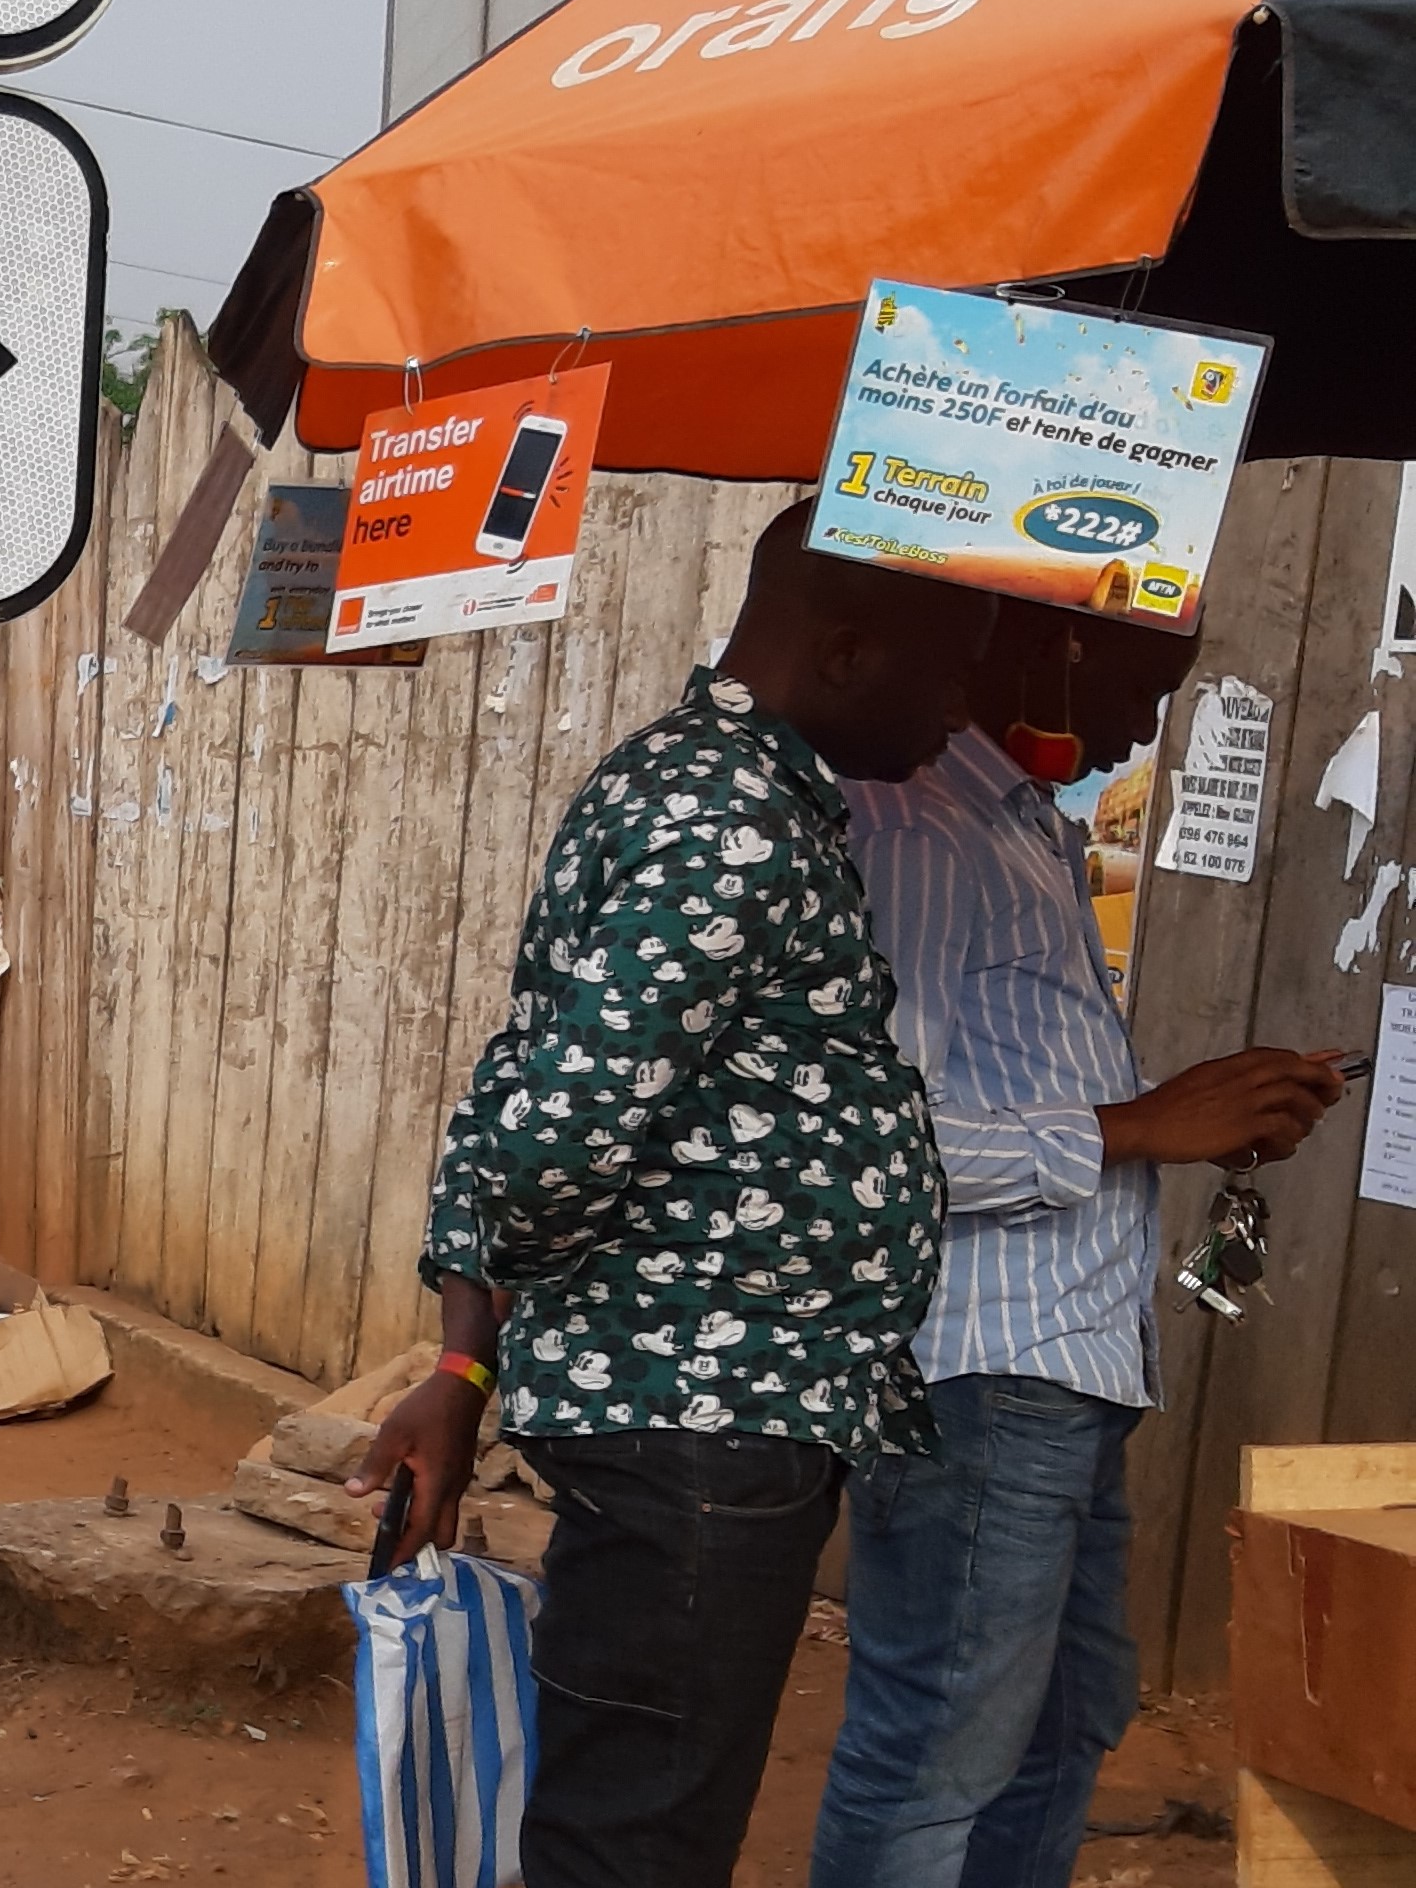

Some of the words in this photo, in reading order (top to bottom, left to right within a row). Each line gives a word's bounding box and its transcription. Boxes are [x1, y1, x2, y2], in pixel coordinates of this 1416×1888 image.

[862, 357, 954, 396] Achète
[956, 377, 990, 399] un
[991, 379, 1078, 418] forfait
[1079, 395, 1136, 431] d'au
[370, 416, 486, 463] Transfer
[857, 384, 934, 416] moins
[938, 398, 1003, 428] 250F
[1005, 416, 1033, 434] et
[1033, 414, 1096, 449] tente
[1097, 431, 1125, 454] de
[1131, 442, 1220, 473] gagner
[359, 463, 454, 505] airtime
[835, 451, 874, 499] 1
[881, 456, 990, 504] Terrain
[352, 513, 413, 545] here
[873, 487, 946, 519] chaque
[945, 500, 992, 526] jour
